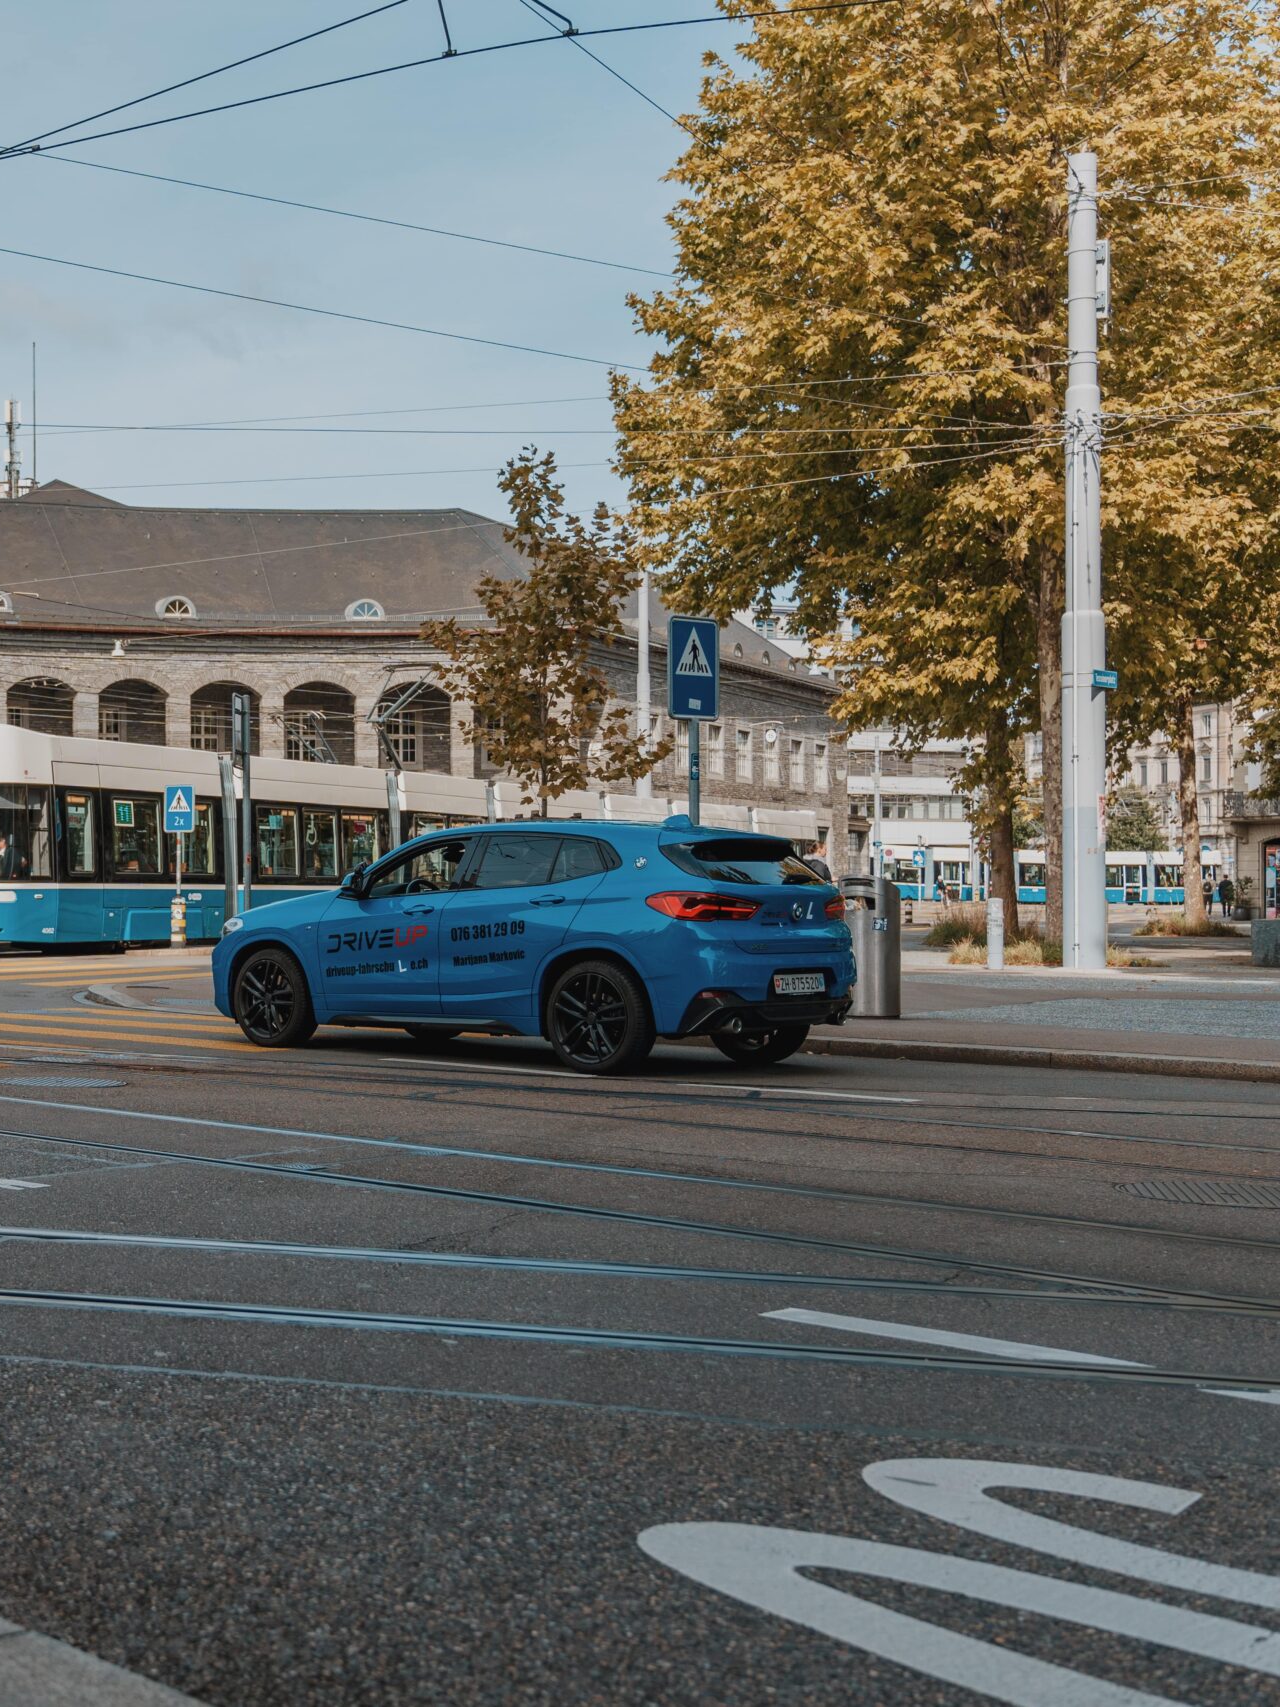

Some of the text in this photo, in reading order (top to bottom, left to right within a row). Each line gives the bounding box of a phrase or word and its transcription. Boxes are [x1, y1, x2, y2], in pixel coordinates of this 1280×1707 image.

[174, 816, 184, 826] 2x
[327, 925, 428, 953] DRIVEUP
[451, 920, 525, 942] 076 381 29 09
